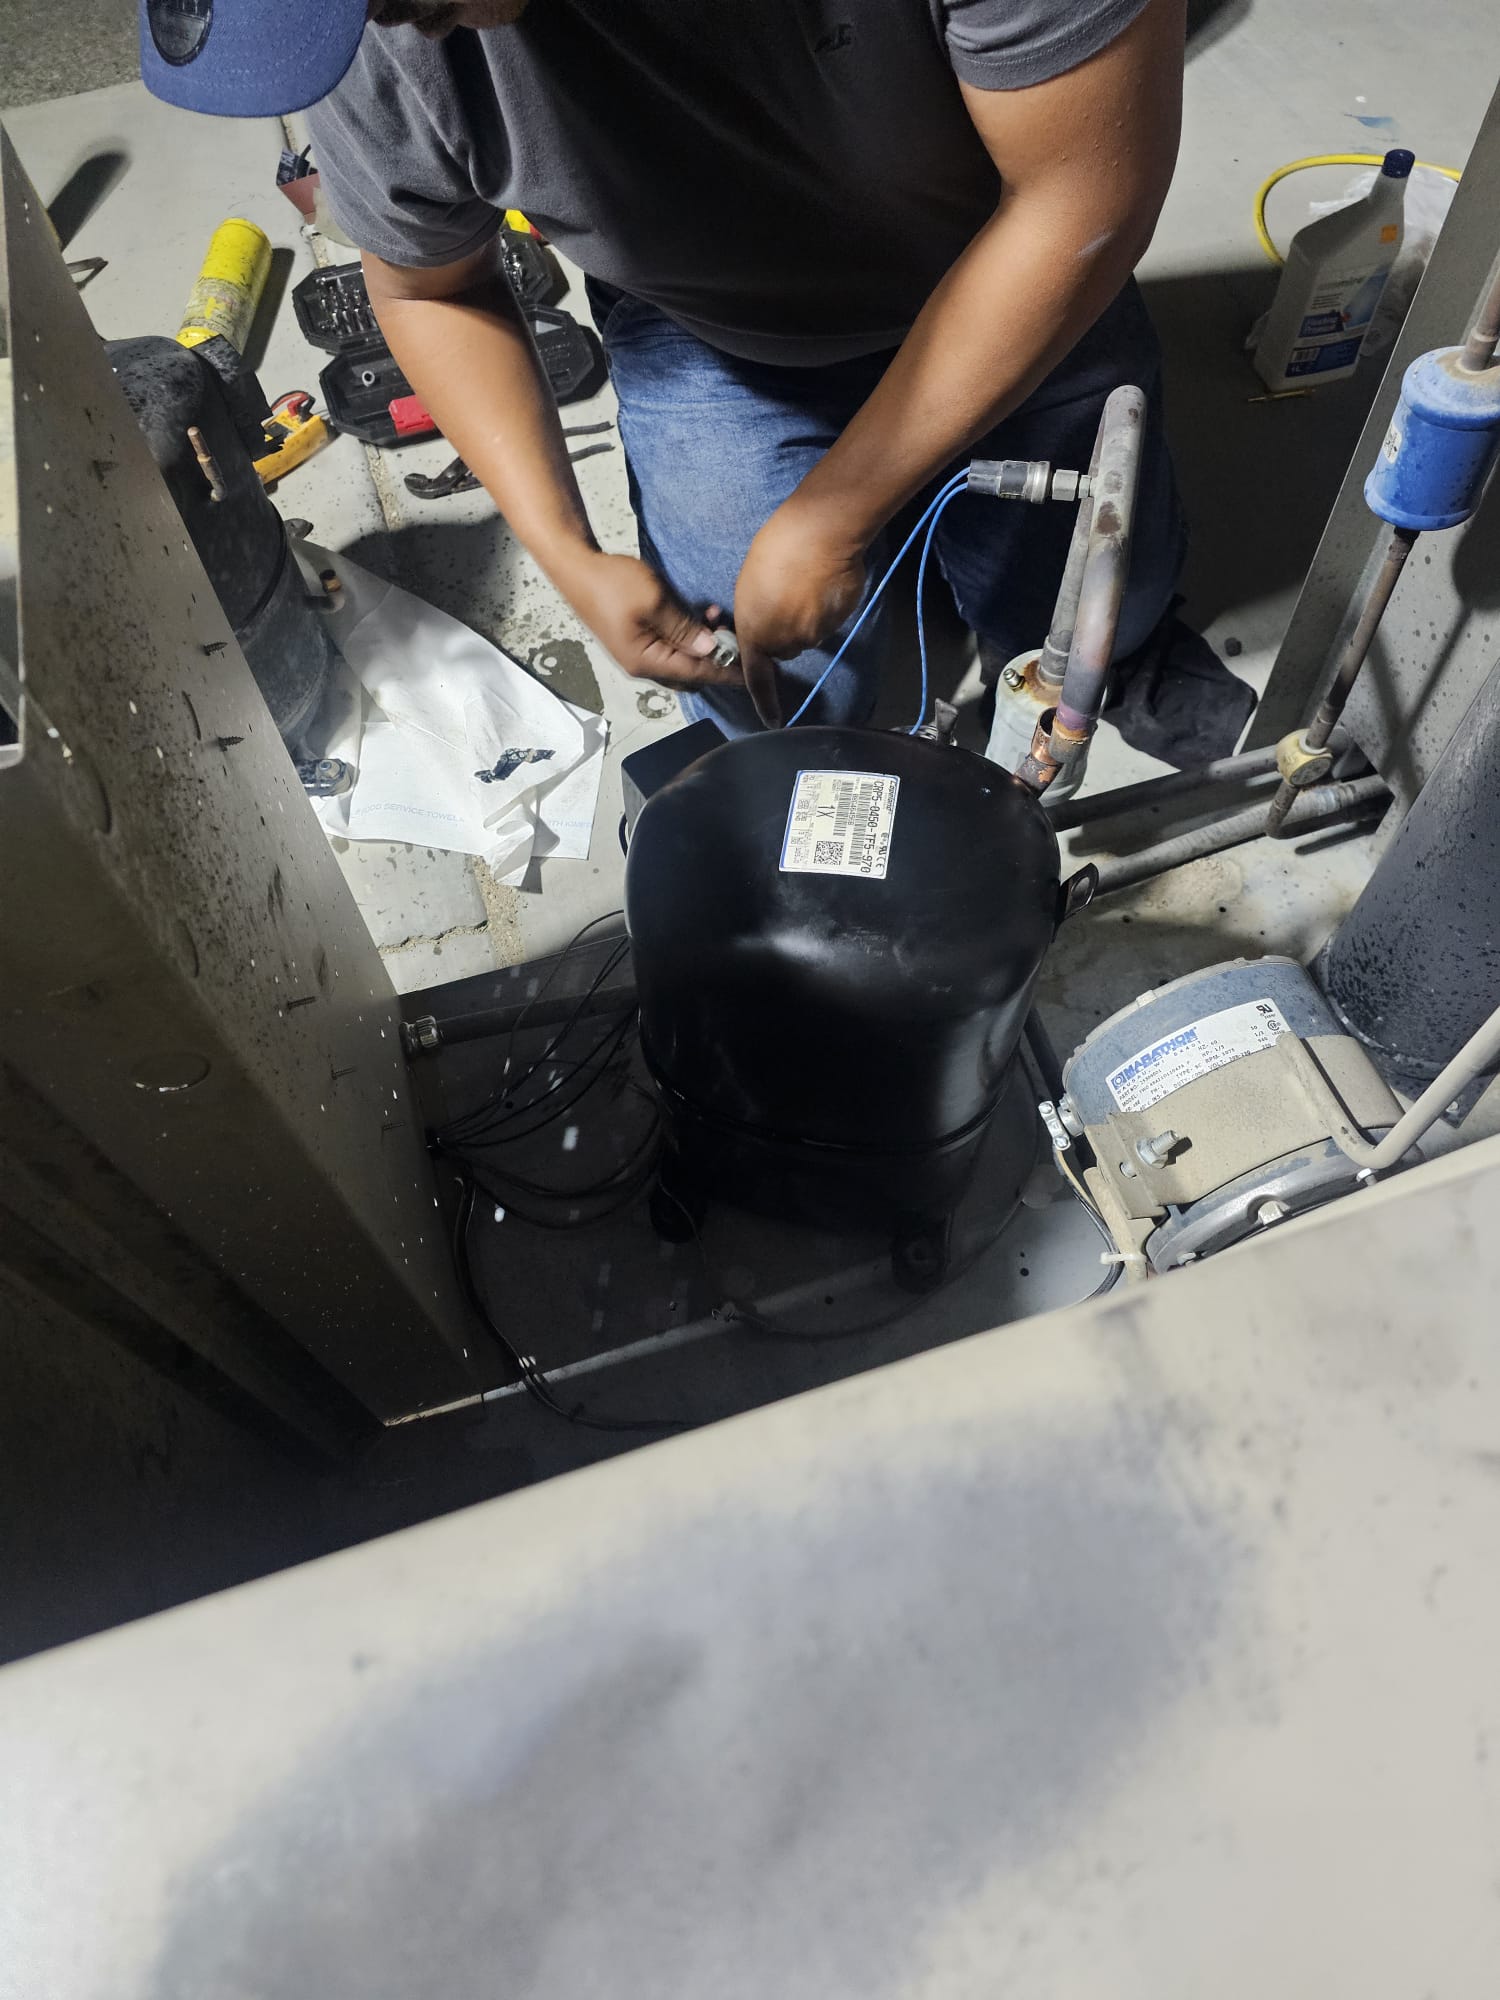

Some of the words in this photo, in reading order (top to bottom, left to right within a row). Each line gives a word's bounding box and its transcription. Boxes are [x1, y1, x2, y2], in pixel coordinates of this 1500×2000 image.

[384, 803, 425, 816] SERVICE
[816, 805, 836, 819] 1X
[860, 780, 885, 874] CRP5-0450-TF5-970
[1123, 1028, 1197, 1081] MARATHON
